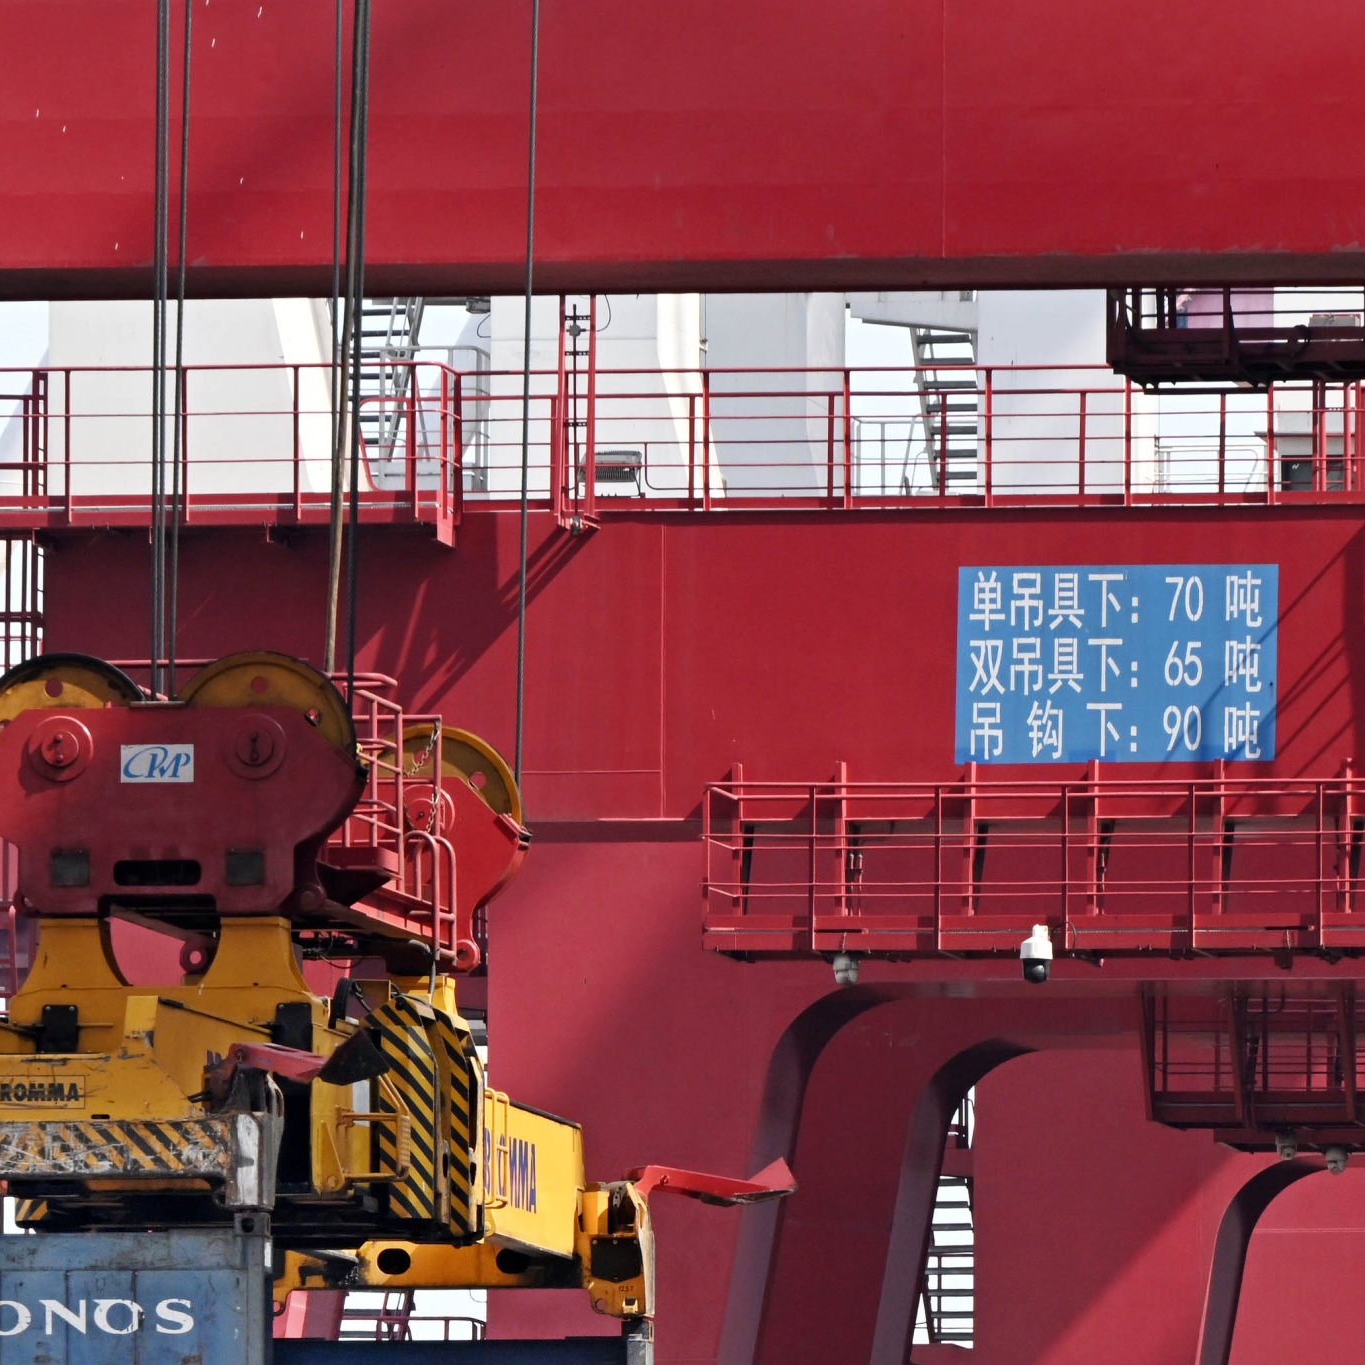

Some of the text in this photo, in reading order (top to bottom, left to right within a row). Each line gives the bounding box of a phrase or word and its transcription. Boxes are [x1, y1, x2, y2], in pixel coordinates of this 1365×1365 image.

[1164, 575, 1204, 622] 70
[1225, 570, 1263, 628] 吨
[1164, 639, 1203, 687] 65
[1224, 635, 1262, 693] 吨
[1162, 705, 1202, 751] 90
[1223, 701, 1261, 759] 吨
